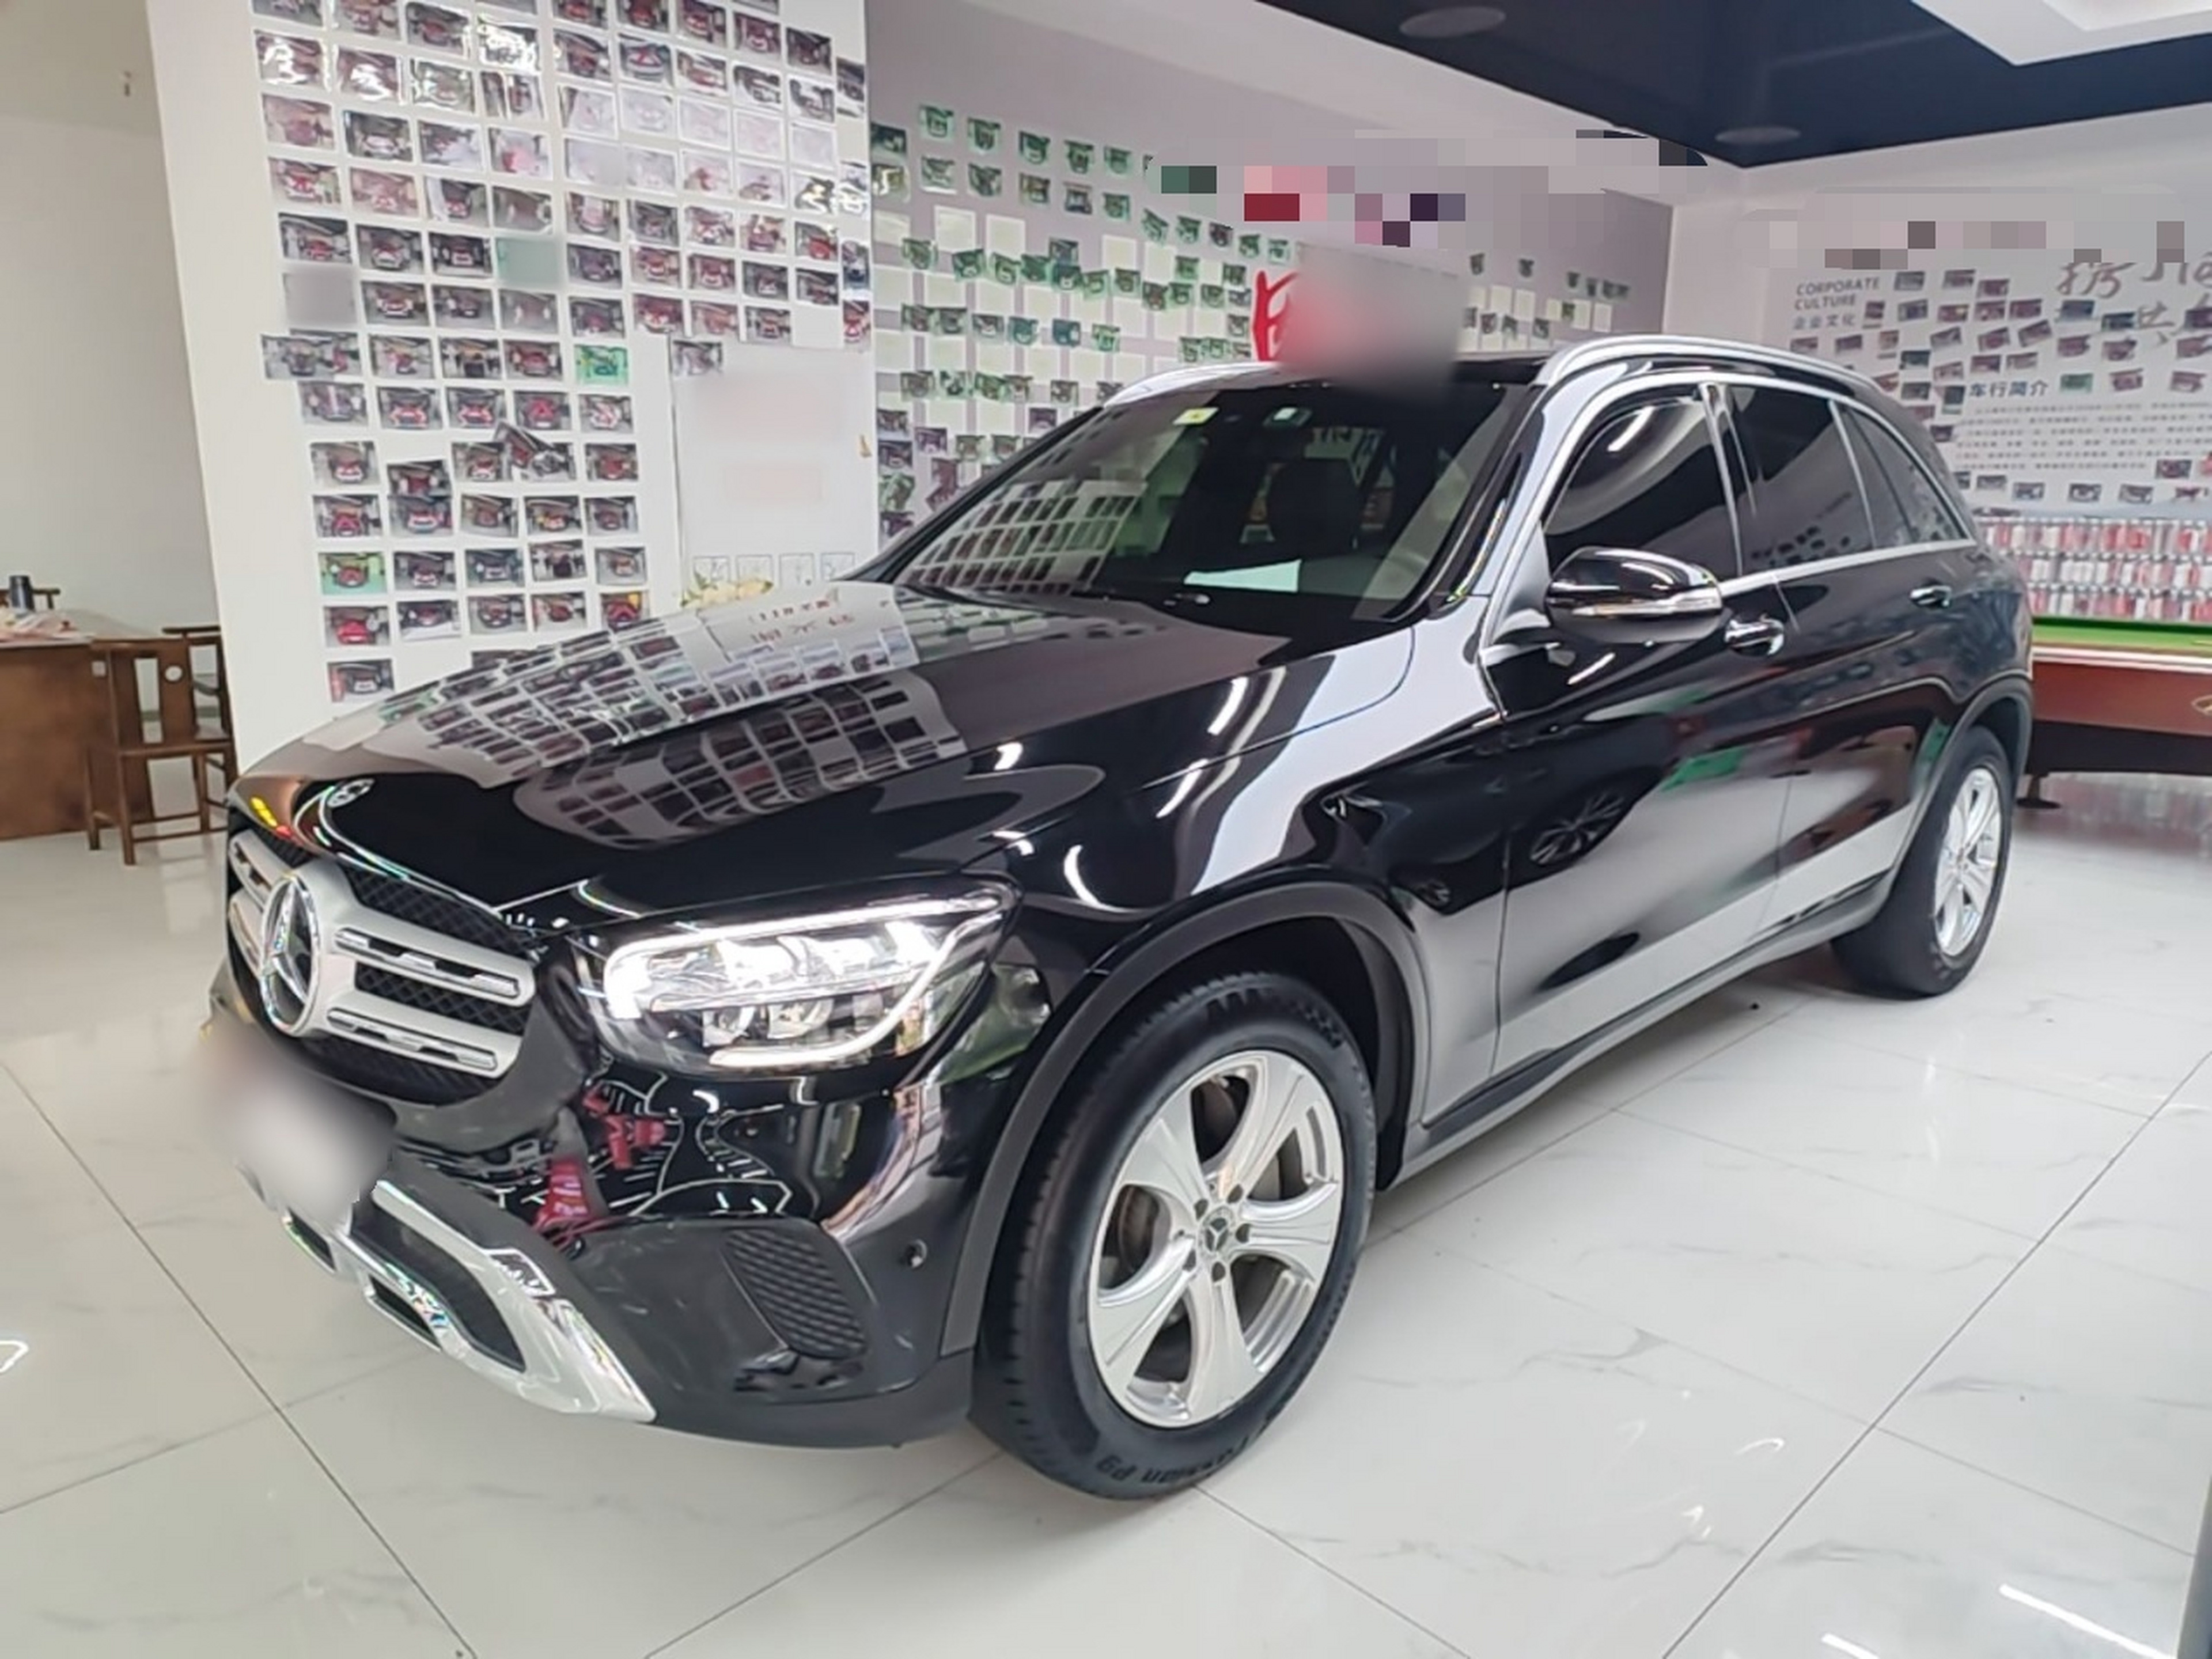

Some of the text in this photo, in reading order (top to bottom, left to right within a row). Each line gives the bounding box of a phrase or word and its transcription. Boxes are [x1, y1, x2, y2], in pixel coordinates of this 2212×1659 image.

[1797, 276, 1880, 296] CORPORATE
[1794, 294, 1856, 310] CULTURE
[1969, 379, 2048, 397] 车行简介
